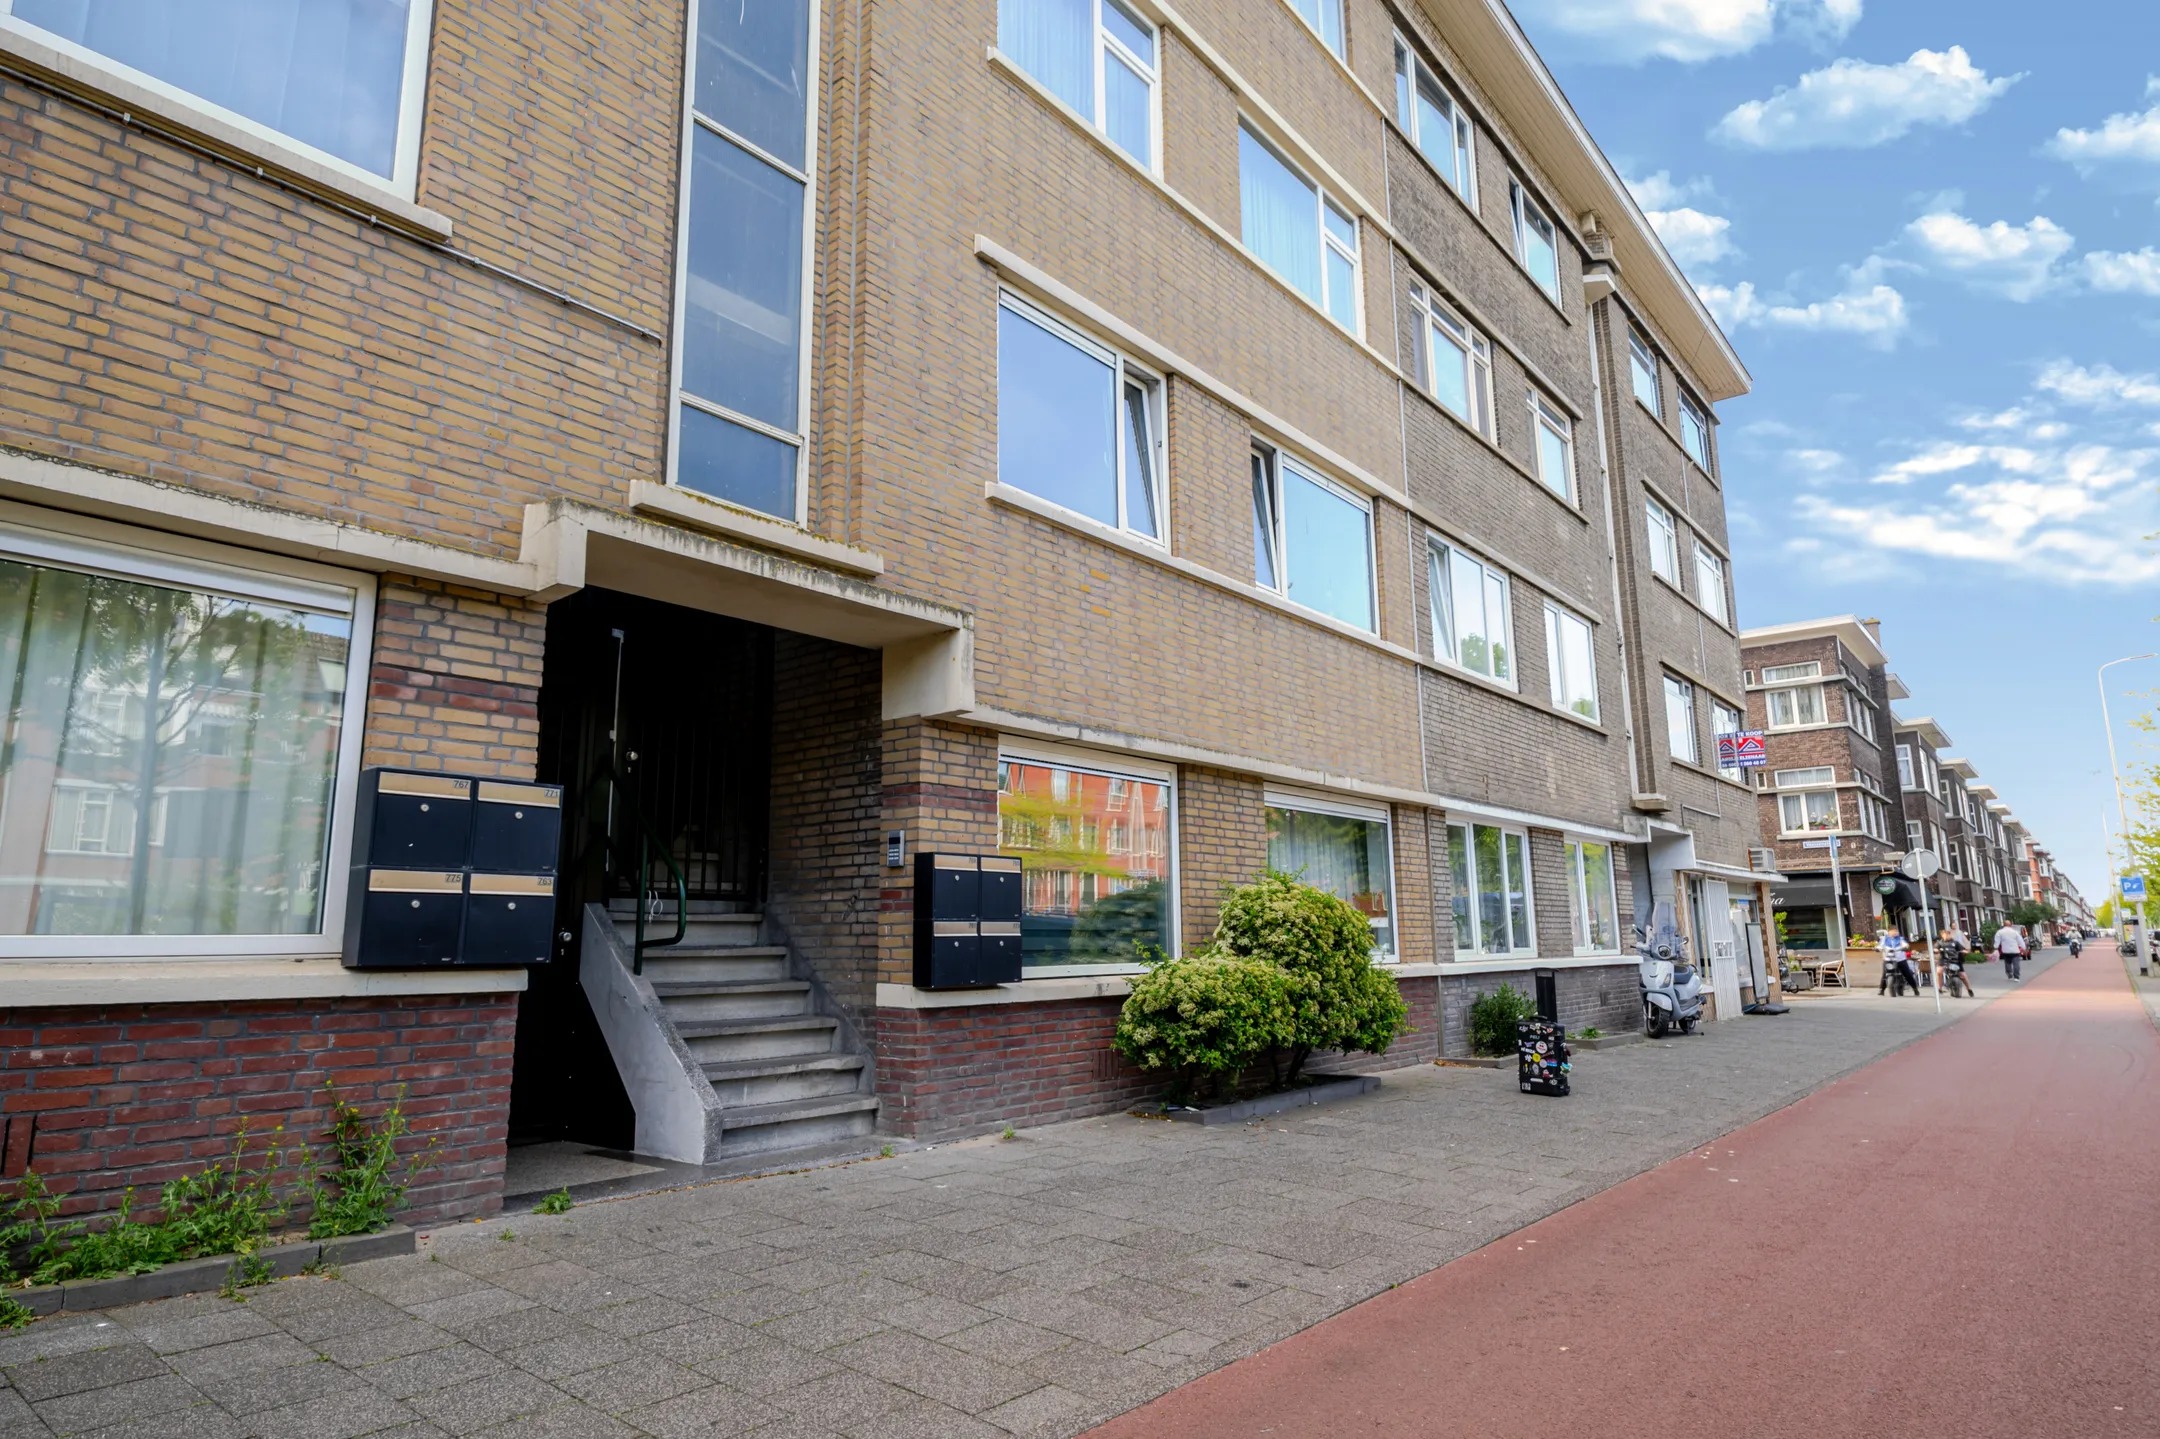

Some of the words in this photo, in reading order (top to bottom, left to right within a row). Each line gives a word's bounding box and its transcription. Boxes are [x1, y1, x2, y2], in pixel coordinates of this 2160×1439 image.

[454, 780, 469, 789] 767
[545, 789, 559, 797] 771
[445, 874, 461, 883] 775
[538, 877, 552, 886] 763
[2123, 882, 2131, 890] P
